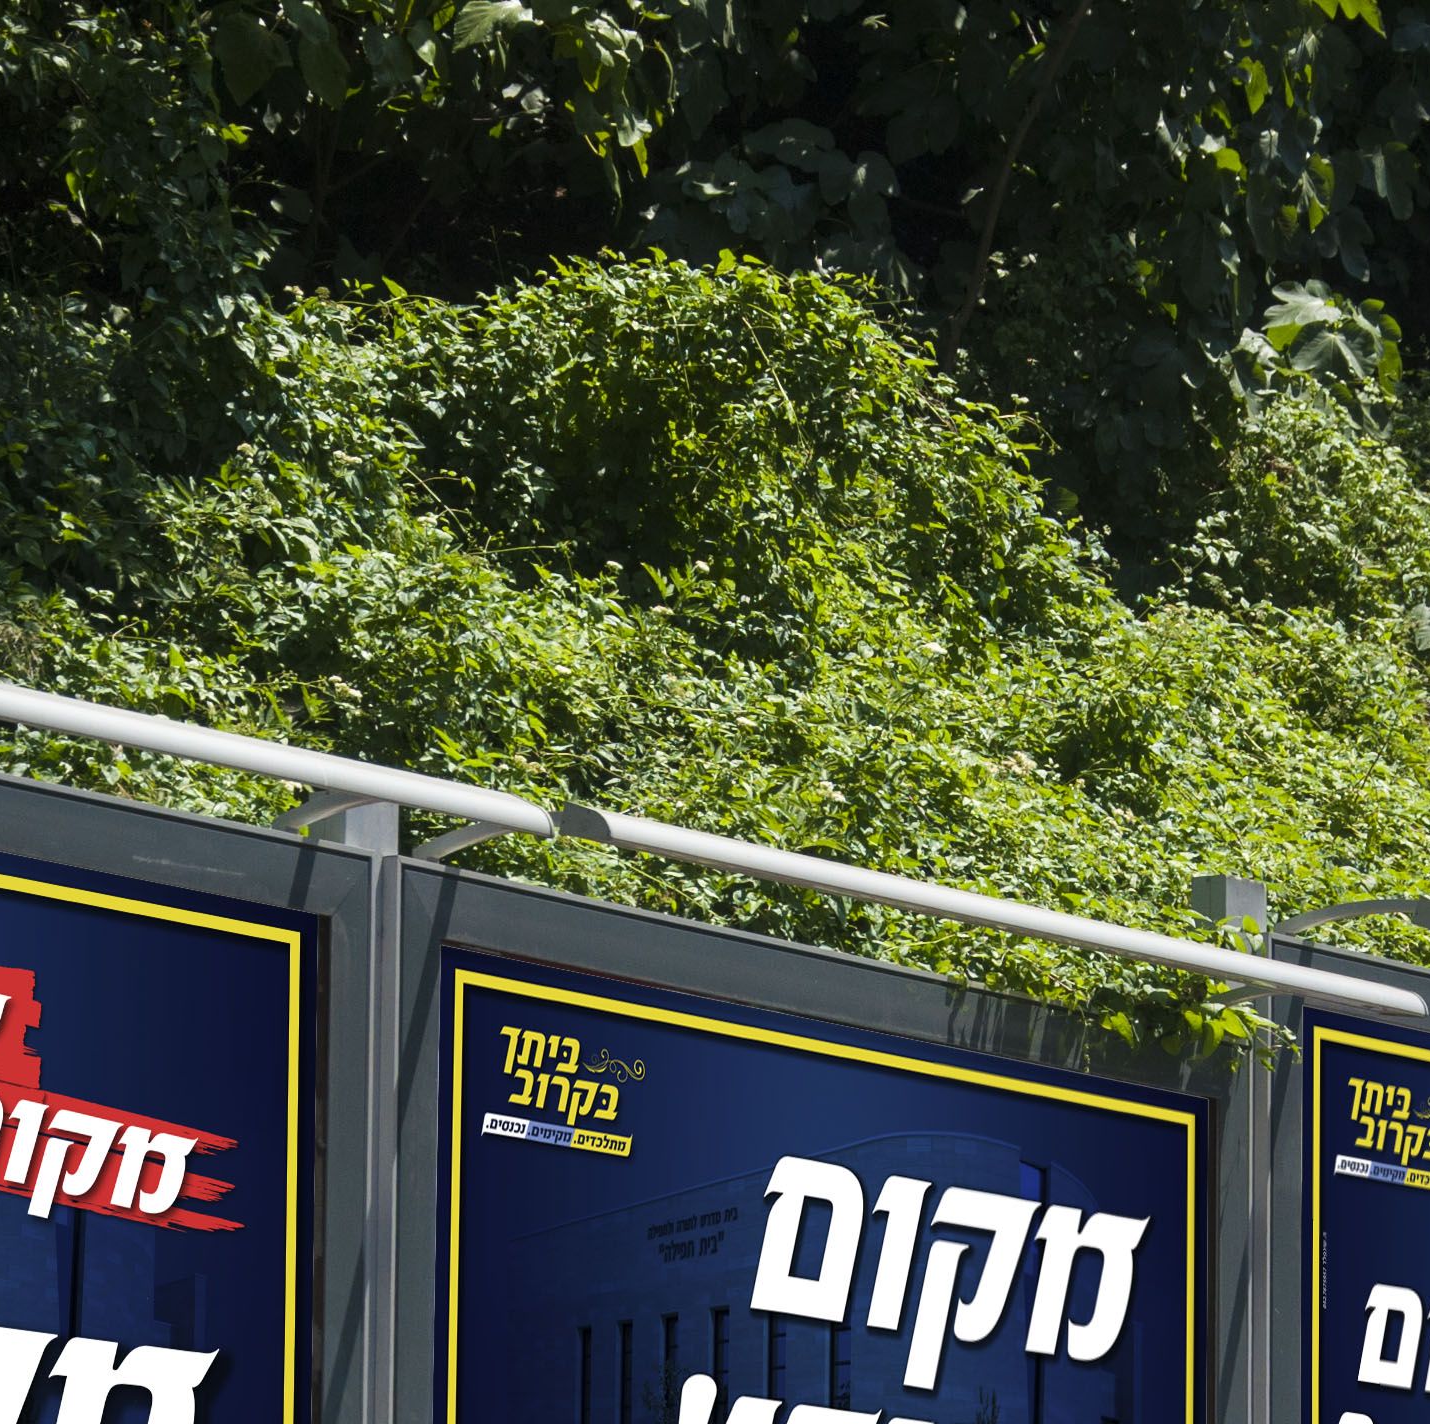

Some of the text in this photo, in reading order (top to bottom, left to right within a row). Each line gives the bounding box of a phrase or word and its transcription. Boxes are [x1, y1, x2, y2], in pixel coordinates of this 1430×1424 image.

[486, 1117, 526, 1134] נכנסים.
[573, 1134, 626, 1152] מתלכדים.
[750, 1155, 1151, 1391] מקום
